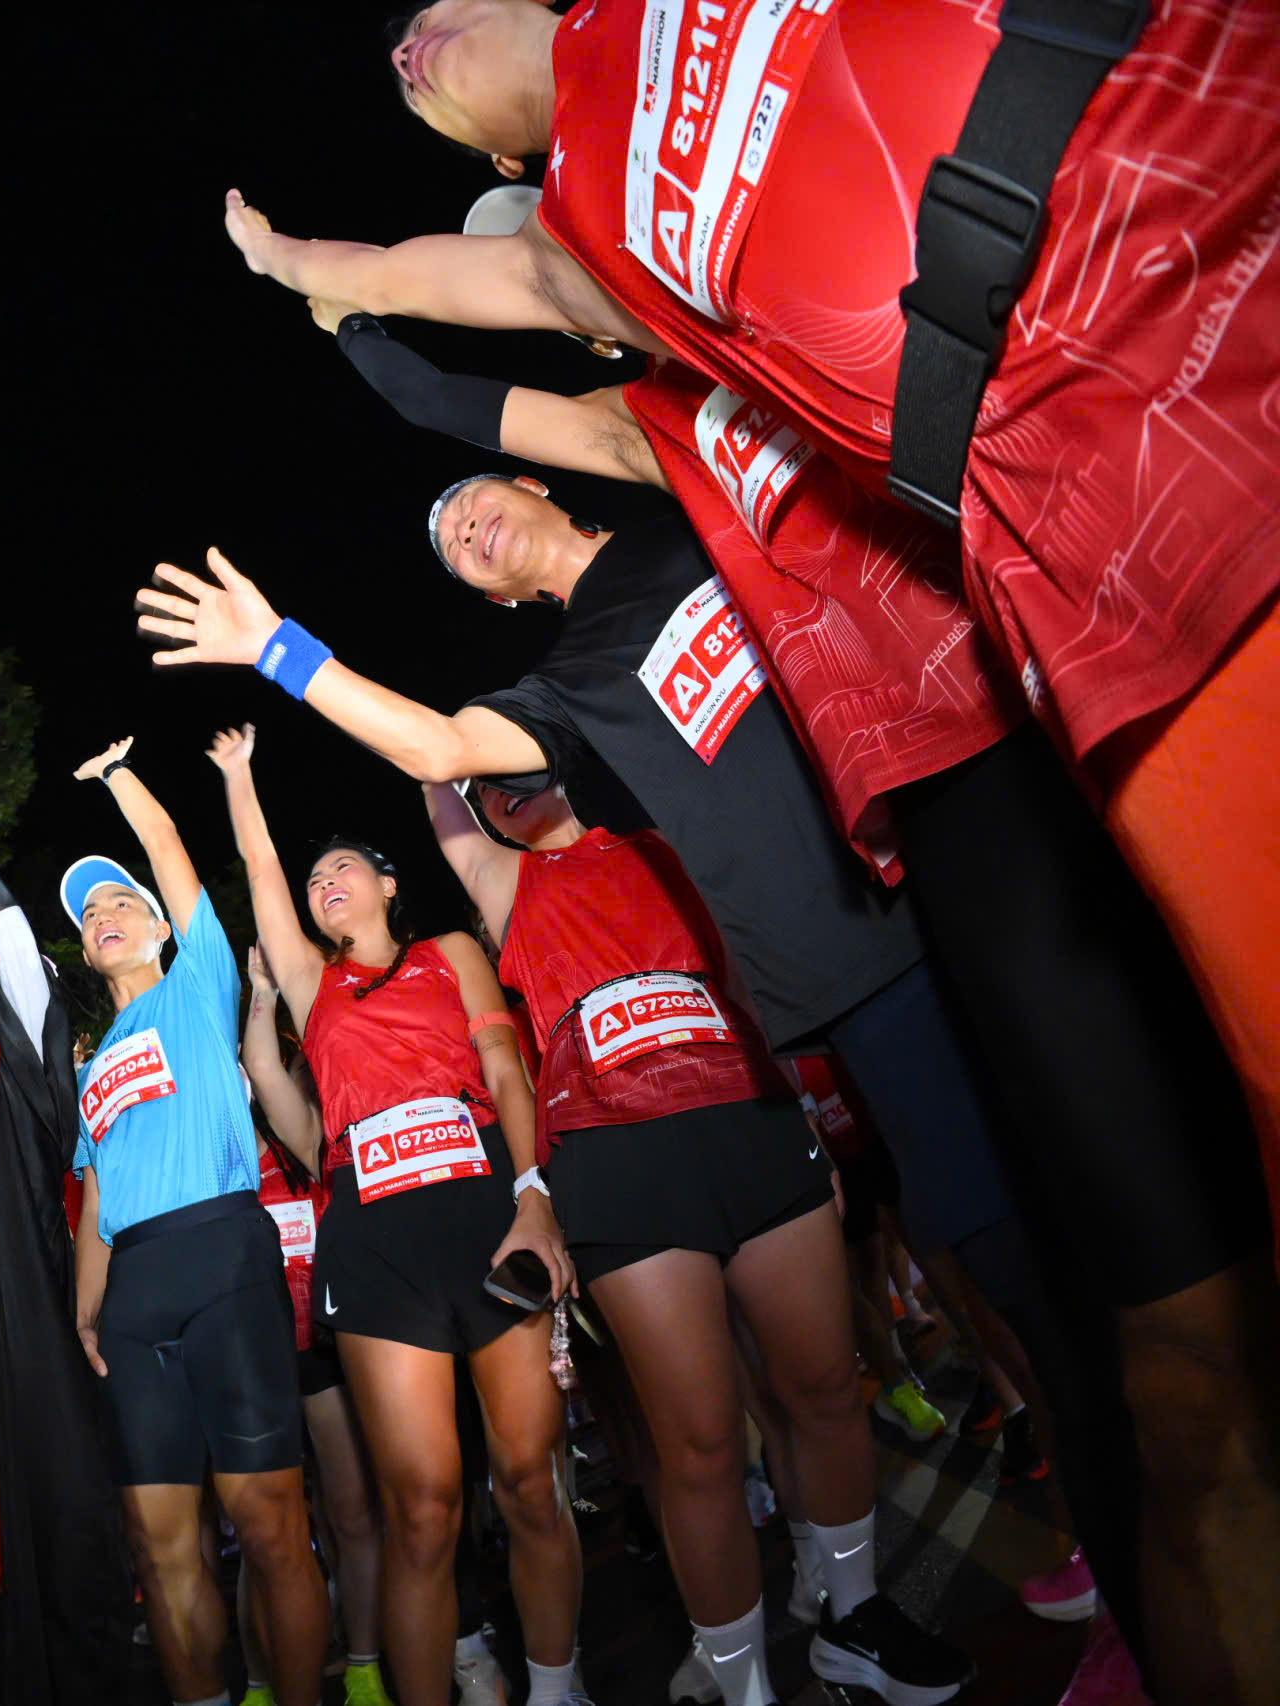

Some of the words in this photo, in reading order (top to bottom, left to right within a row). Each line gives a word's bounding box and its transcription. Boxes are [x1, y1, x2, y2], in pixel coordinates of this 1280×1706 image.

[653, 10, 666, 85] MARATHON
[658, 210, 688, 280] A
[699, 215, 712, 249] NAM
[713, 188, 749, 285] MARATHON
[733, 408, 771, 452] 81
[672, 672, 705, 716] A
[694, 713, 709, 733] KANG
[706, 702, 717, 716] SIN
[715, 688, 727, 705] KYU
[706, 728, 720, 750] HALF
[717, 690, 748, 732] MARATHON
[632, 995, 710, 1015] 672065
[599, 1011, 624, 1041] A
[604, 1056, 620, 1066] HALF
[621, 1040, 658, 1057] MARATHON
[102, 1053, 160, 1090] 672044
[86, 1091, 99, 1116] A
[417, 1108, 444, 1116] MARATHON
[398, 1125, 471, 1149] 672050
[366, 1142, 391, 1168] A
[369, 1187, 385, 1196] HALF
[385, 1177, 419, 1190] MARATHON
